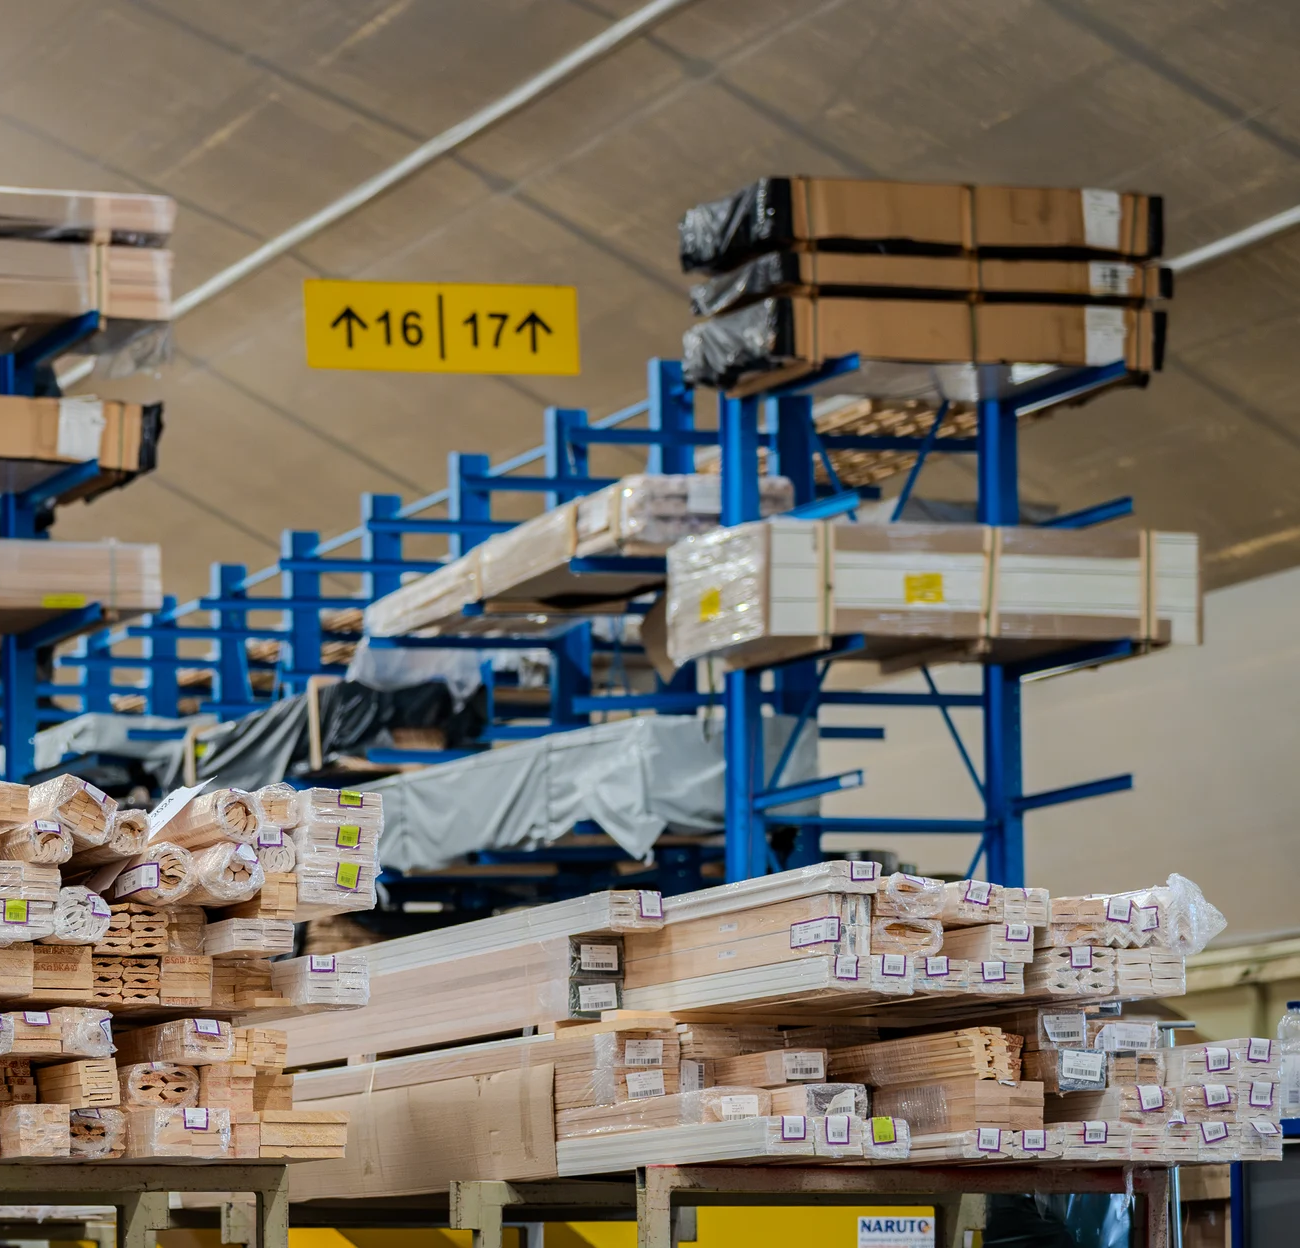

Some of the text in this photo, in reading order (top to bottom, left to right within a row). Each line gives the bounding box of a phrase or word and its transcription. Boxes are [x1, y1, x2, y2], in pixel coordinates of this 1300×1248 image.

[376, 310, 510, 349] 16 17
[861, 1219, 930, 1234] NARUTO
